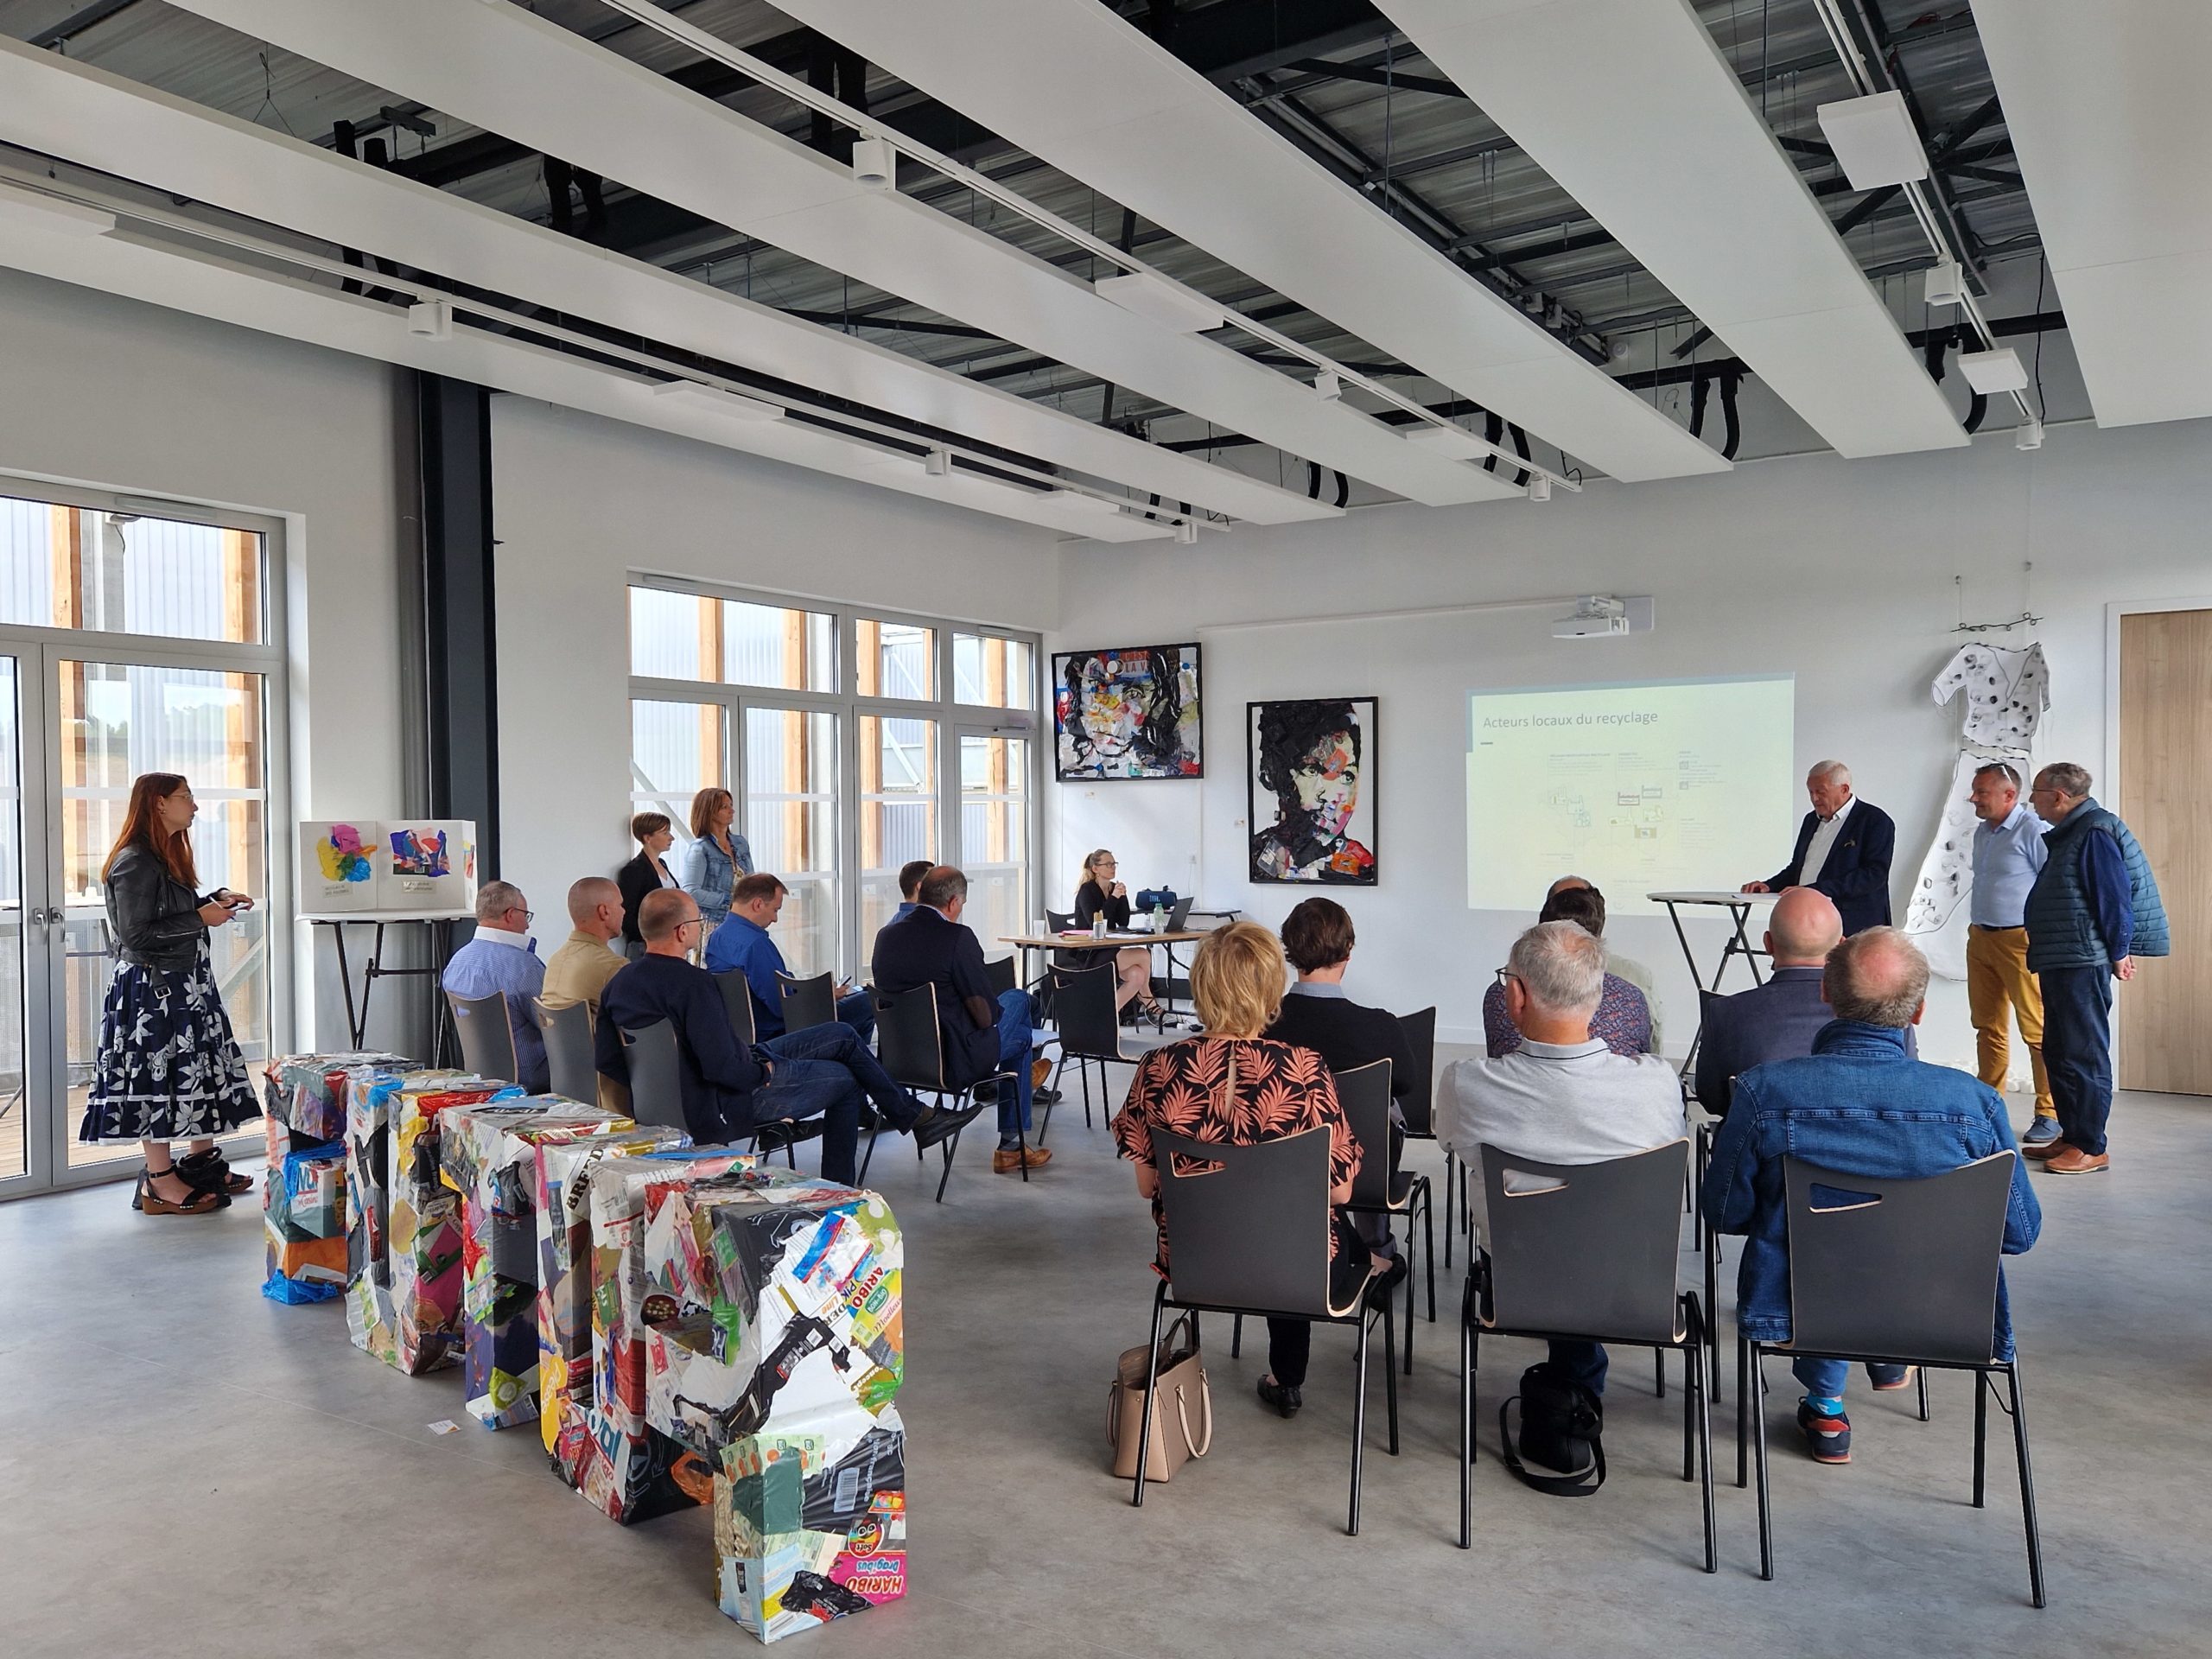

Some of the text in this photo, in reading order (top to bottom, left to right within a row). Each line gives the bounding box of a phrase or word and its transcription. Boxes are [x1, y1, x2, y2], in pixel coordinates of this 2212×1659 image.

[1483, 711, 1659, 728] Acteurs locaux du recyclage
[852, 1267, 885, 1308] ARIBO
[821, 1295, 839, 1314] Line
[855, 1543, 873, 1553] Soft
[856, 1560, 899, 1574] Dragibus
[845, 1576, 903, 1595] HARIBO
